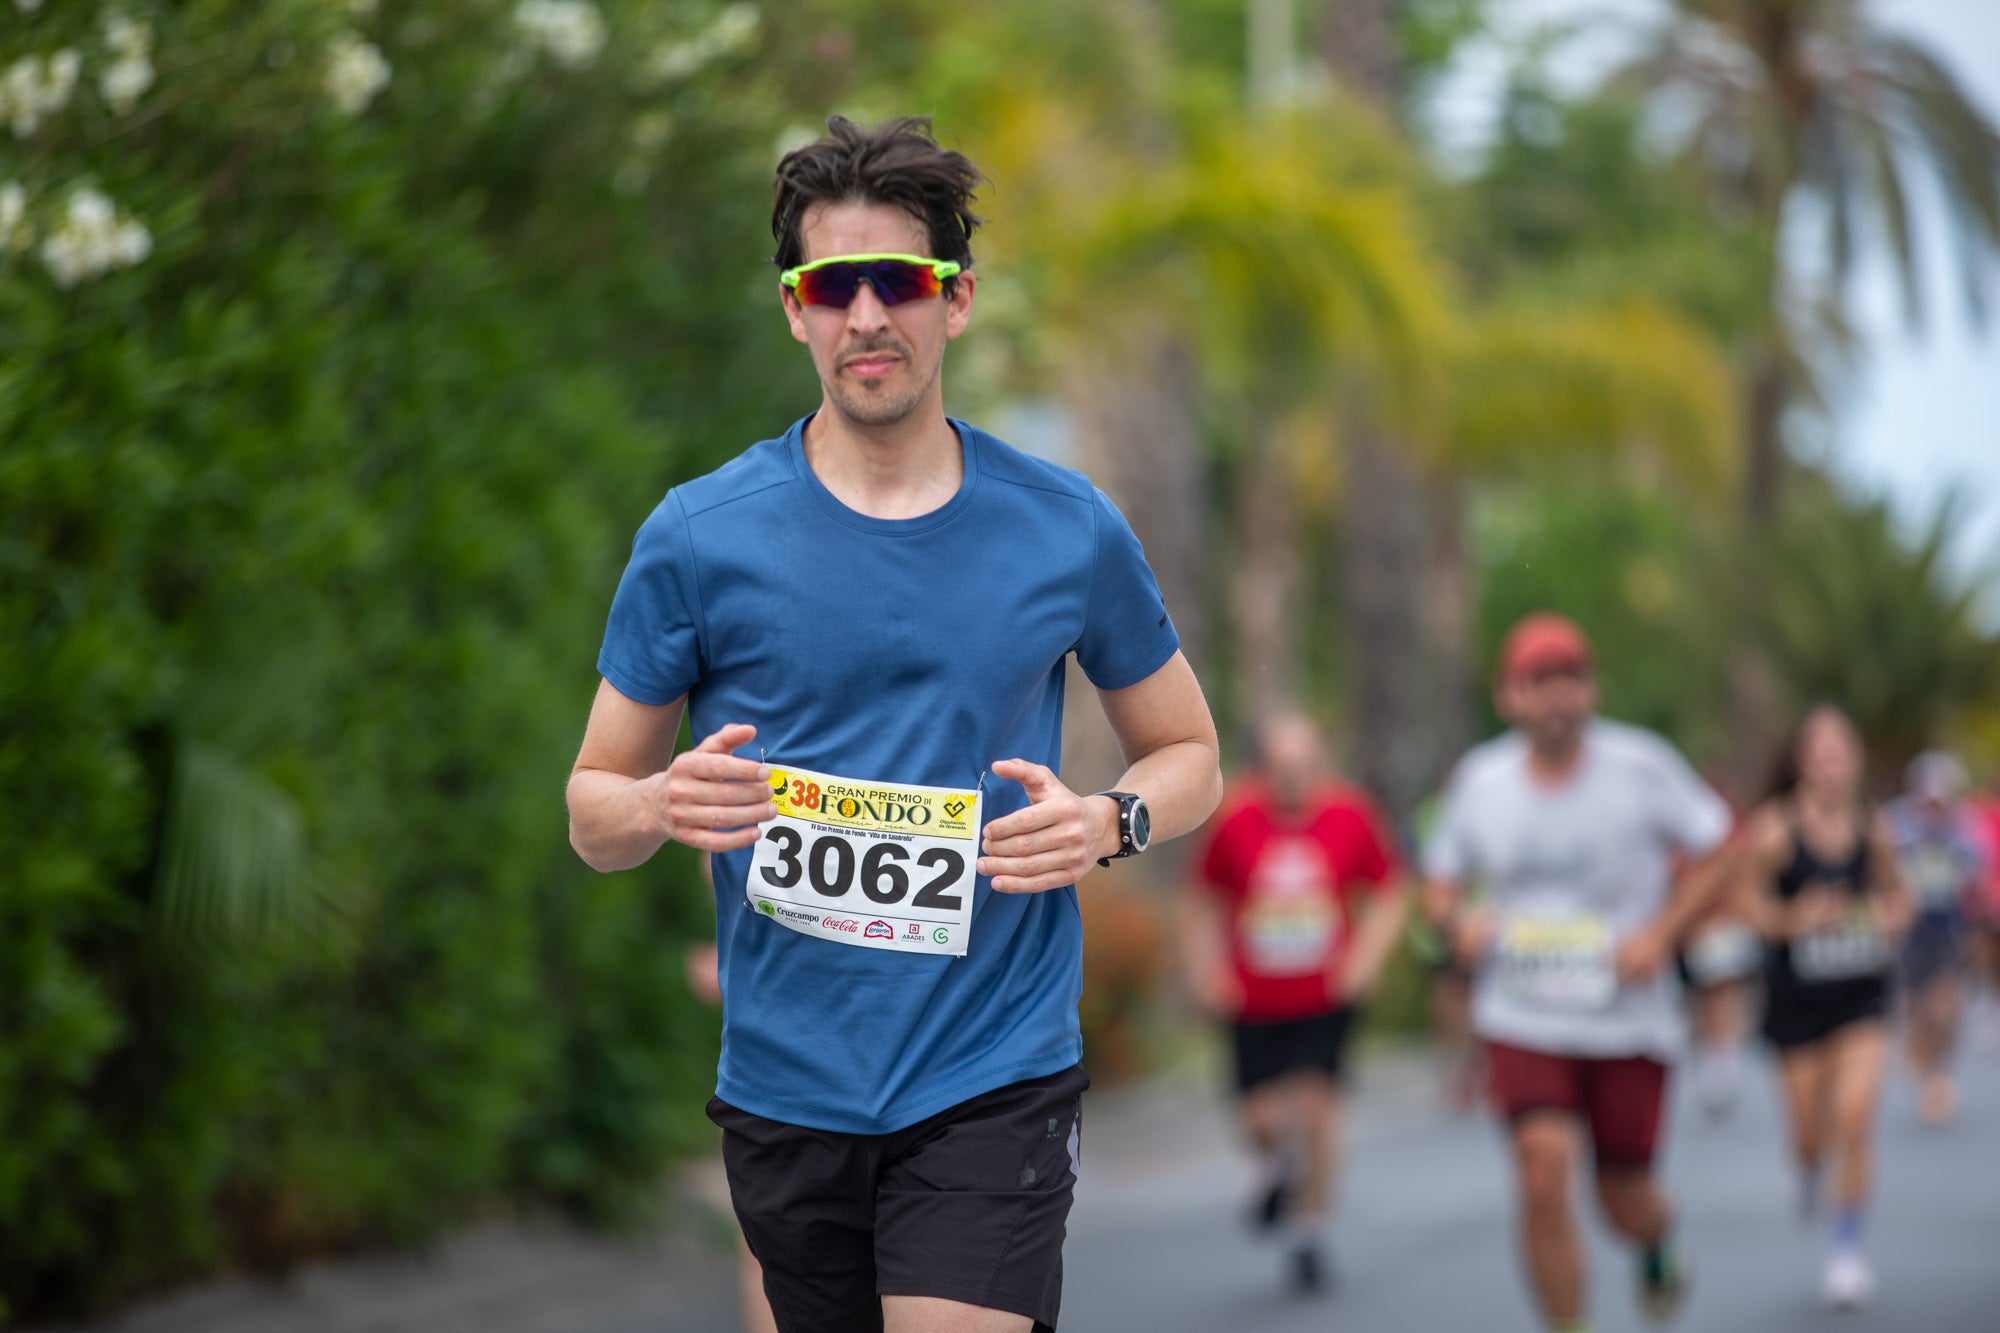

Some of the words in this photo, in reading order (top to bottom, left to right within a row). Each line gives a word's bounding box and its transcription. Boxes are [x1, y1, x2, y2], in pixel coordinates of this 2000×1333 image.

[790, 779, 820, 809] 38
[827, 785, 865, 798] GRAN
[869, 791, 922, 804] PREMIO
[820, 793, 929, 825] FONDO
[828, 826, 844, 834] Premio
[760, 826, 966, 910] 3062
[777, 907, 820, 922] Cruzcampo
